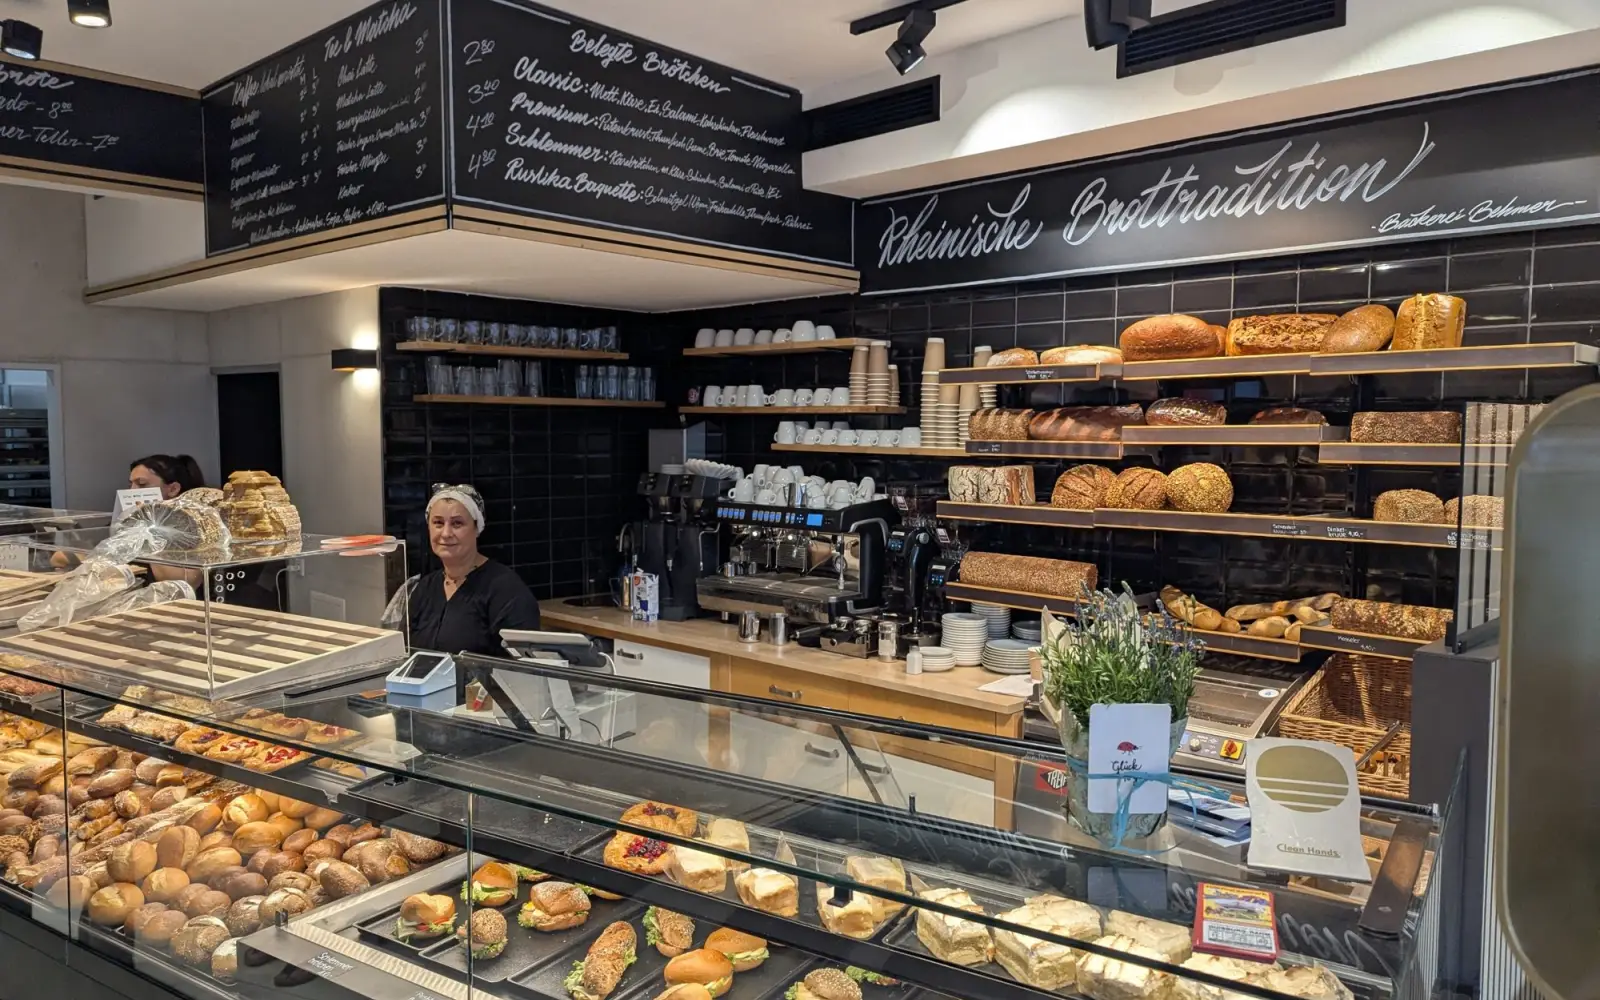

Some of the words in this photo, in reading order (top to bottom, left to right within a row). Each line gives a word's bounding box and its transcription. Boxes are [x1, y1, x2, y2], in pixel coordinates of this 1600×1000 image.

[324, 35, 342, 62] Tee
[354, 1, 417, 47] Matcha
[569, 29, 637, 68] Belegte
[642, 51, 731, 94] Brötchen
[33, 126, 84, 147] Teller
[504, 157, 573, 190] Rustika
[878, 183, 1044, 269] Rheinische
[1063, 121, 1436, 247] Brottradition
[1468, 196, 1574, 223] Behmer
[1110, 759, 1143, 775] Glück
[1276, 843, 1304, 854] Clean
